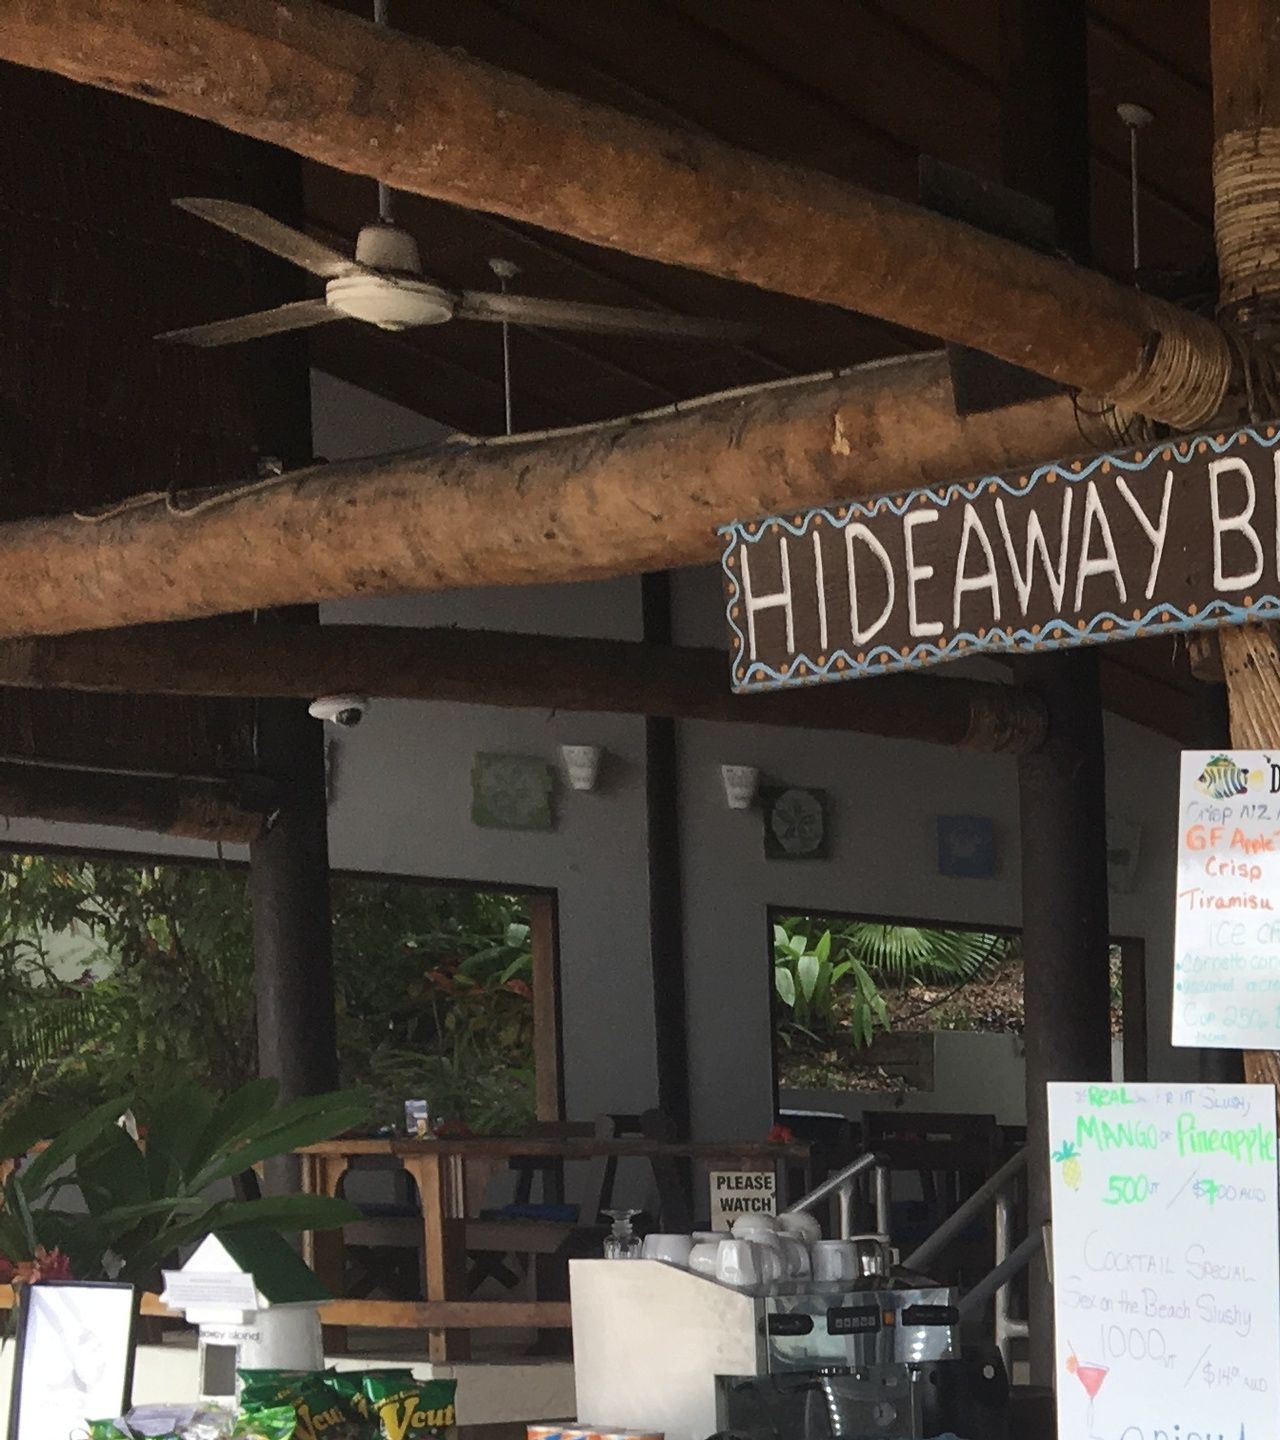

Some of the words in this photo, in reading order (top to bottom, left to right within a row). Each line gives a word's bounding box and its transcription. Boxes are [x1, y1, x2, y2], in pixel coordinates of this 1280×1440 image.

[739, 470, 1174, 661] HIDEAWAY
[1185, 824, 1227, 851] GF
[1229, 828, 1276, 855] Apple
[1204, 855, 1263, 883] Crisp
[1178, 887, 1275, 911] Tiramisu
[1075, 1114, 1159, 1152] MANGO
[1177, 1111, 1276, 1165] Pineapple
[716, 1175, 773, 1191] PLEASE
[719, 1196, 772, 1213] WATCH
[1117, 1289, 1139, 1315] the
[1141, 1286, 1192, 1320] Beach
[1195, 1293, 1252, 1338] Slushy
